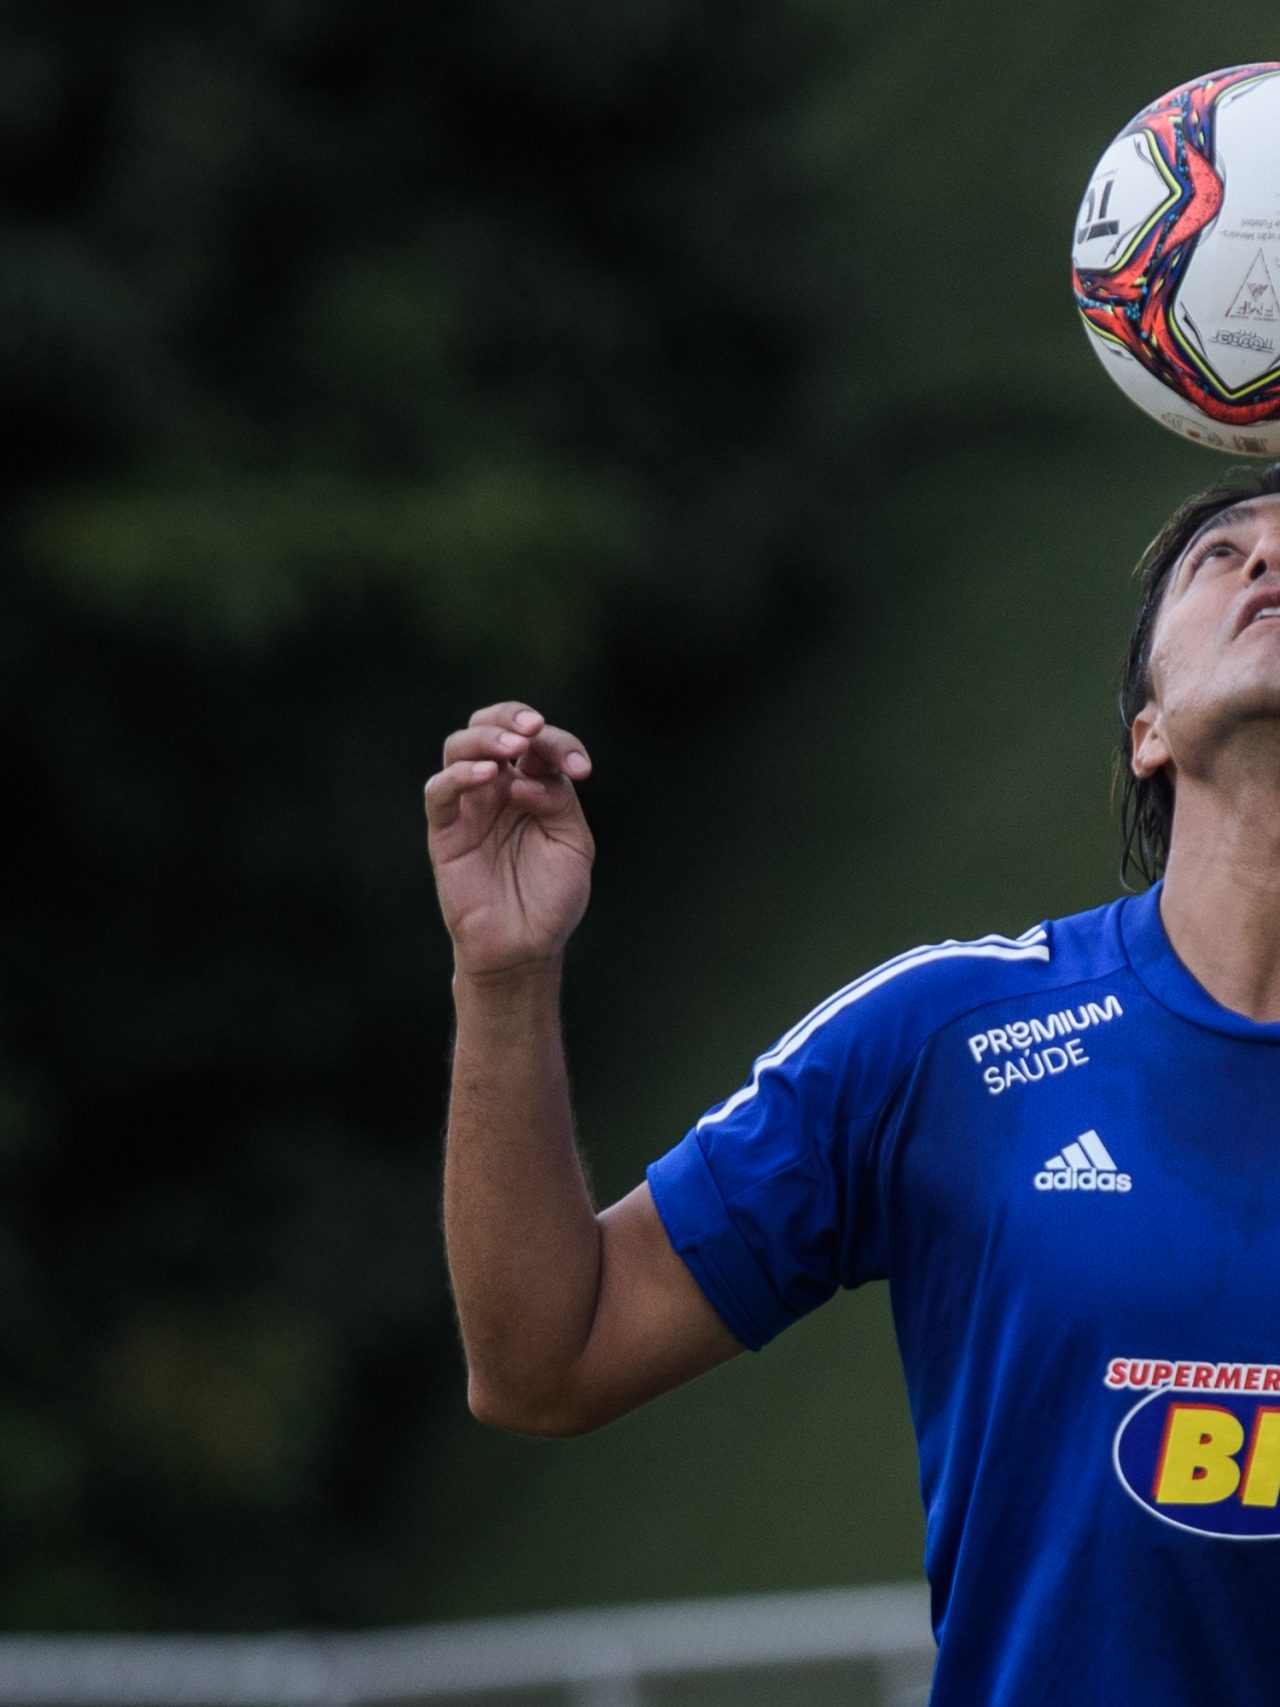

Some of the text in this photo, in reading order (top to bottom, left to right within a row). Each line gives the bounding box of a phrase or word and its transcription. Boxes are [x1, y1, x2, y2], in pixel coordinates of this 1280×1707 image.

[1237, 301, 1275, 317] FMF
[968, 995, 1124, 1064] PREMIUM
[983, 1038, 1090, 1095] SAÚDE
[1033, 1166, 1133, 1193] adidas
